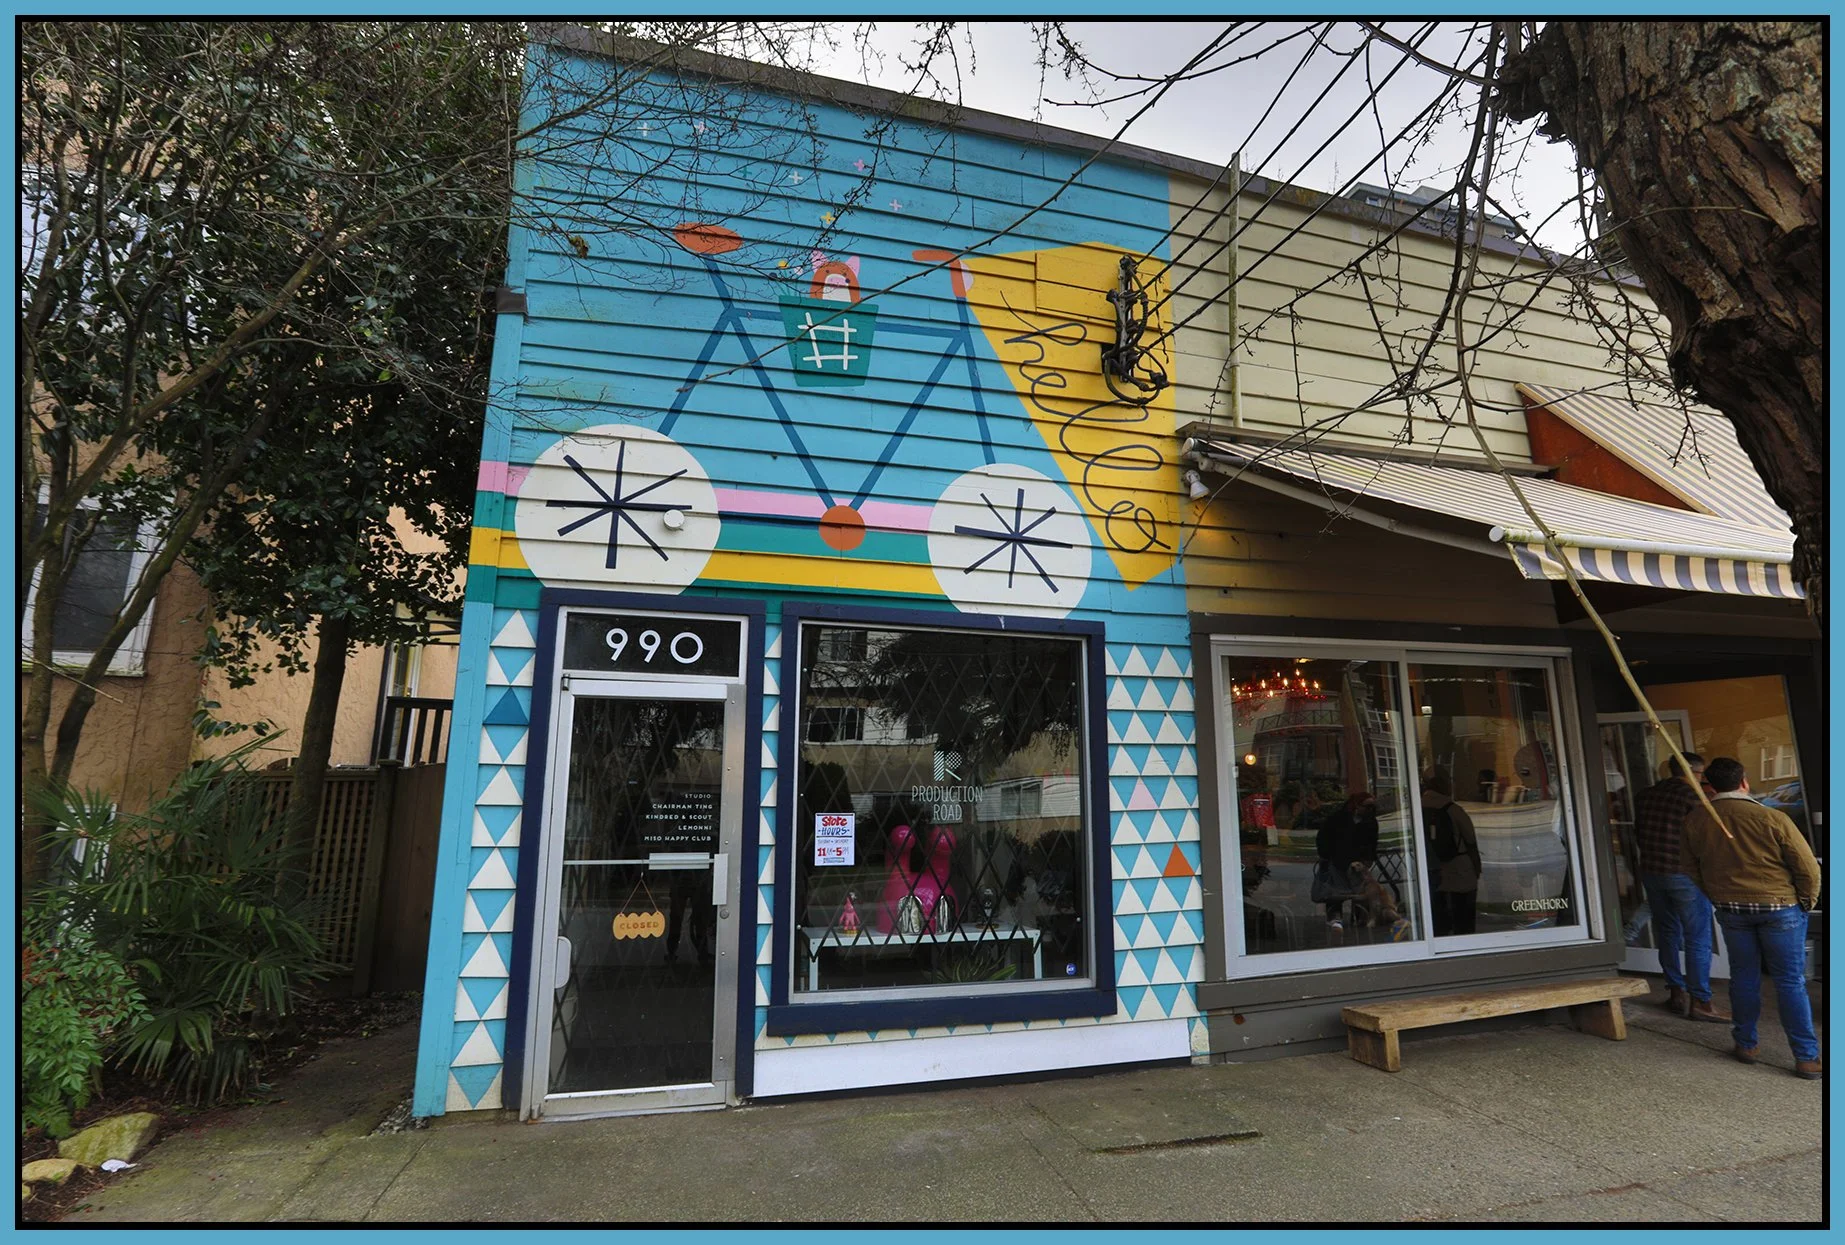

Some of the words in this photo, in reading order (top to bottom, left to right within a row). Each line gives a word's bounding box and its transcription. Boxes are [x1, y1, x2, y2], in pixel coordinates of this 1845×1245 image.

[1000, 289, 1171, 555] hello
[606, 628, 704, 664] 990
[911, 785, 983, 802] PRODUCTION
[933, 803, 963, 821] ROAD
[1511, 898, 1569, 912] GREENHORN
[620, 921, 659, 930] CLOSED
